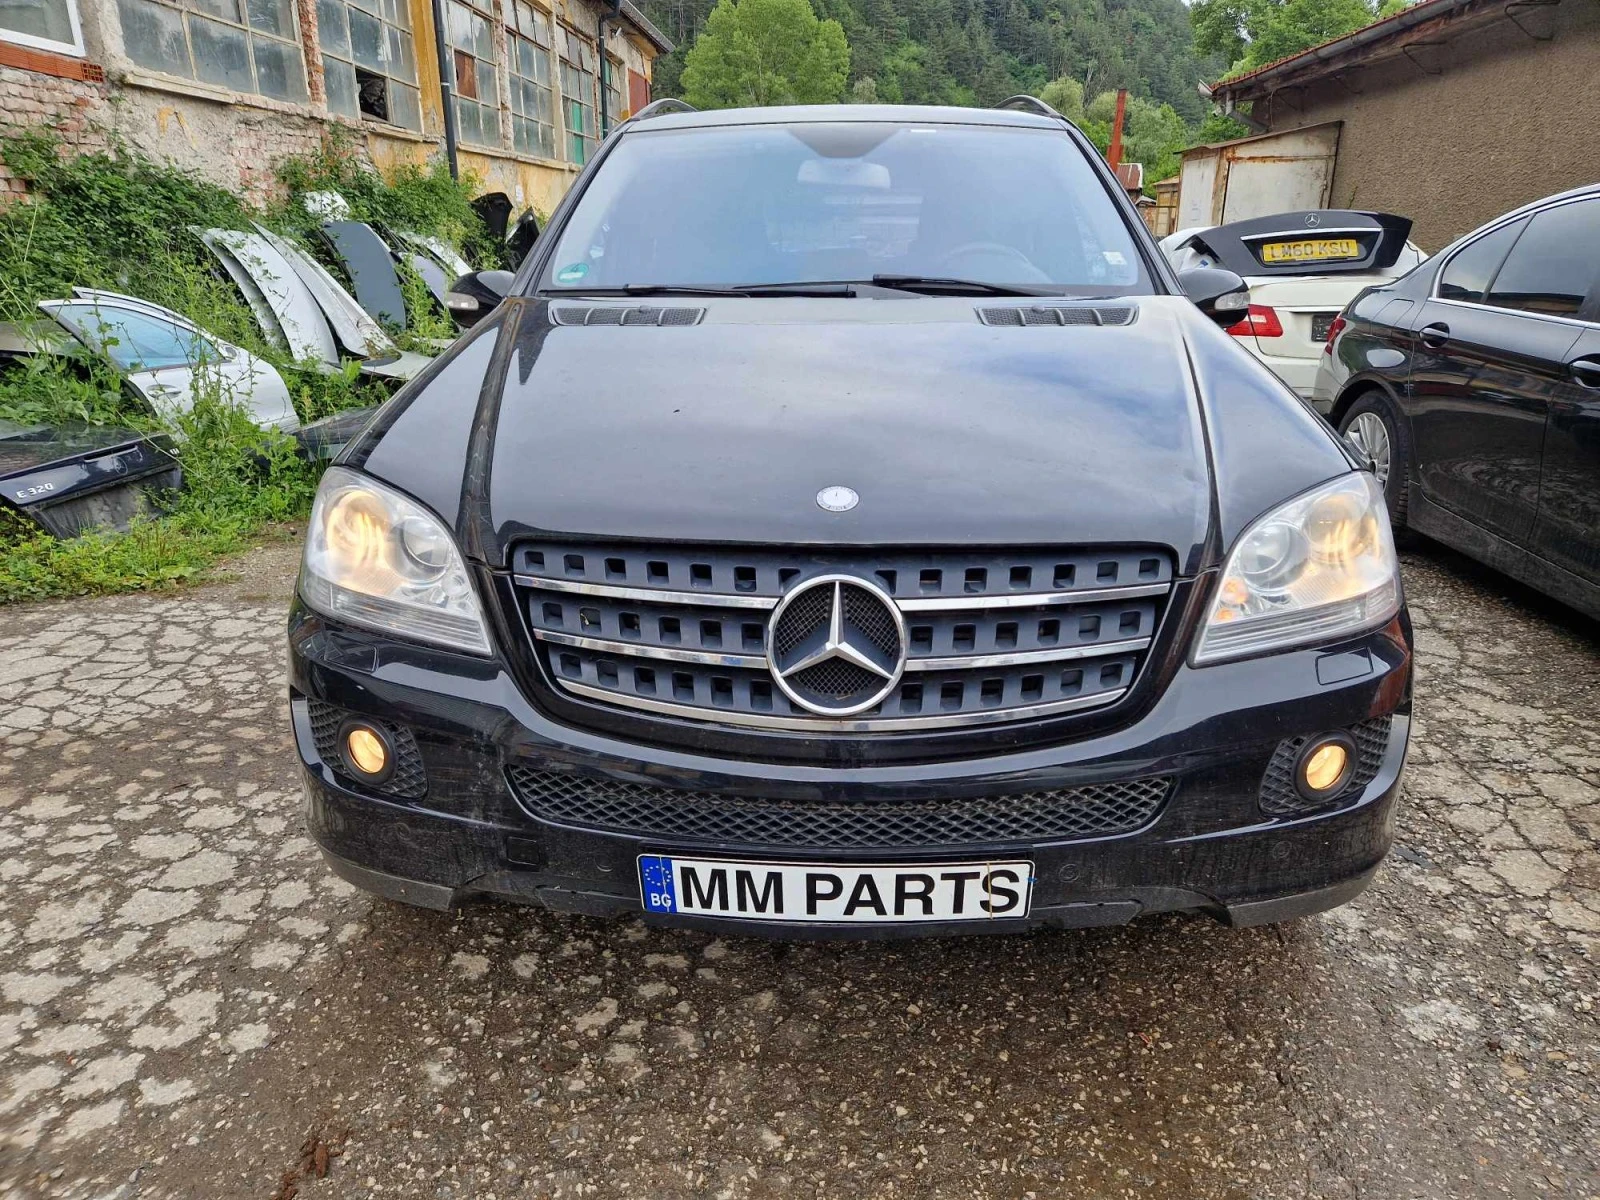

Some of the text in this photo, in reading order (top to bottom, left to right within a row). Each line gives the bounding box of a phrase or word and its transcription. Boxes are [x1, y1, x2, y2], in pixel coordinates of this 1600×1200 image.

[1270, 241, 1350, 258] LM60 KSU
[16, 482, 54, 498] E 320
[680, 866, 1020, 916] MM PARTS
[650, 892, 672, 908] BG
